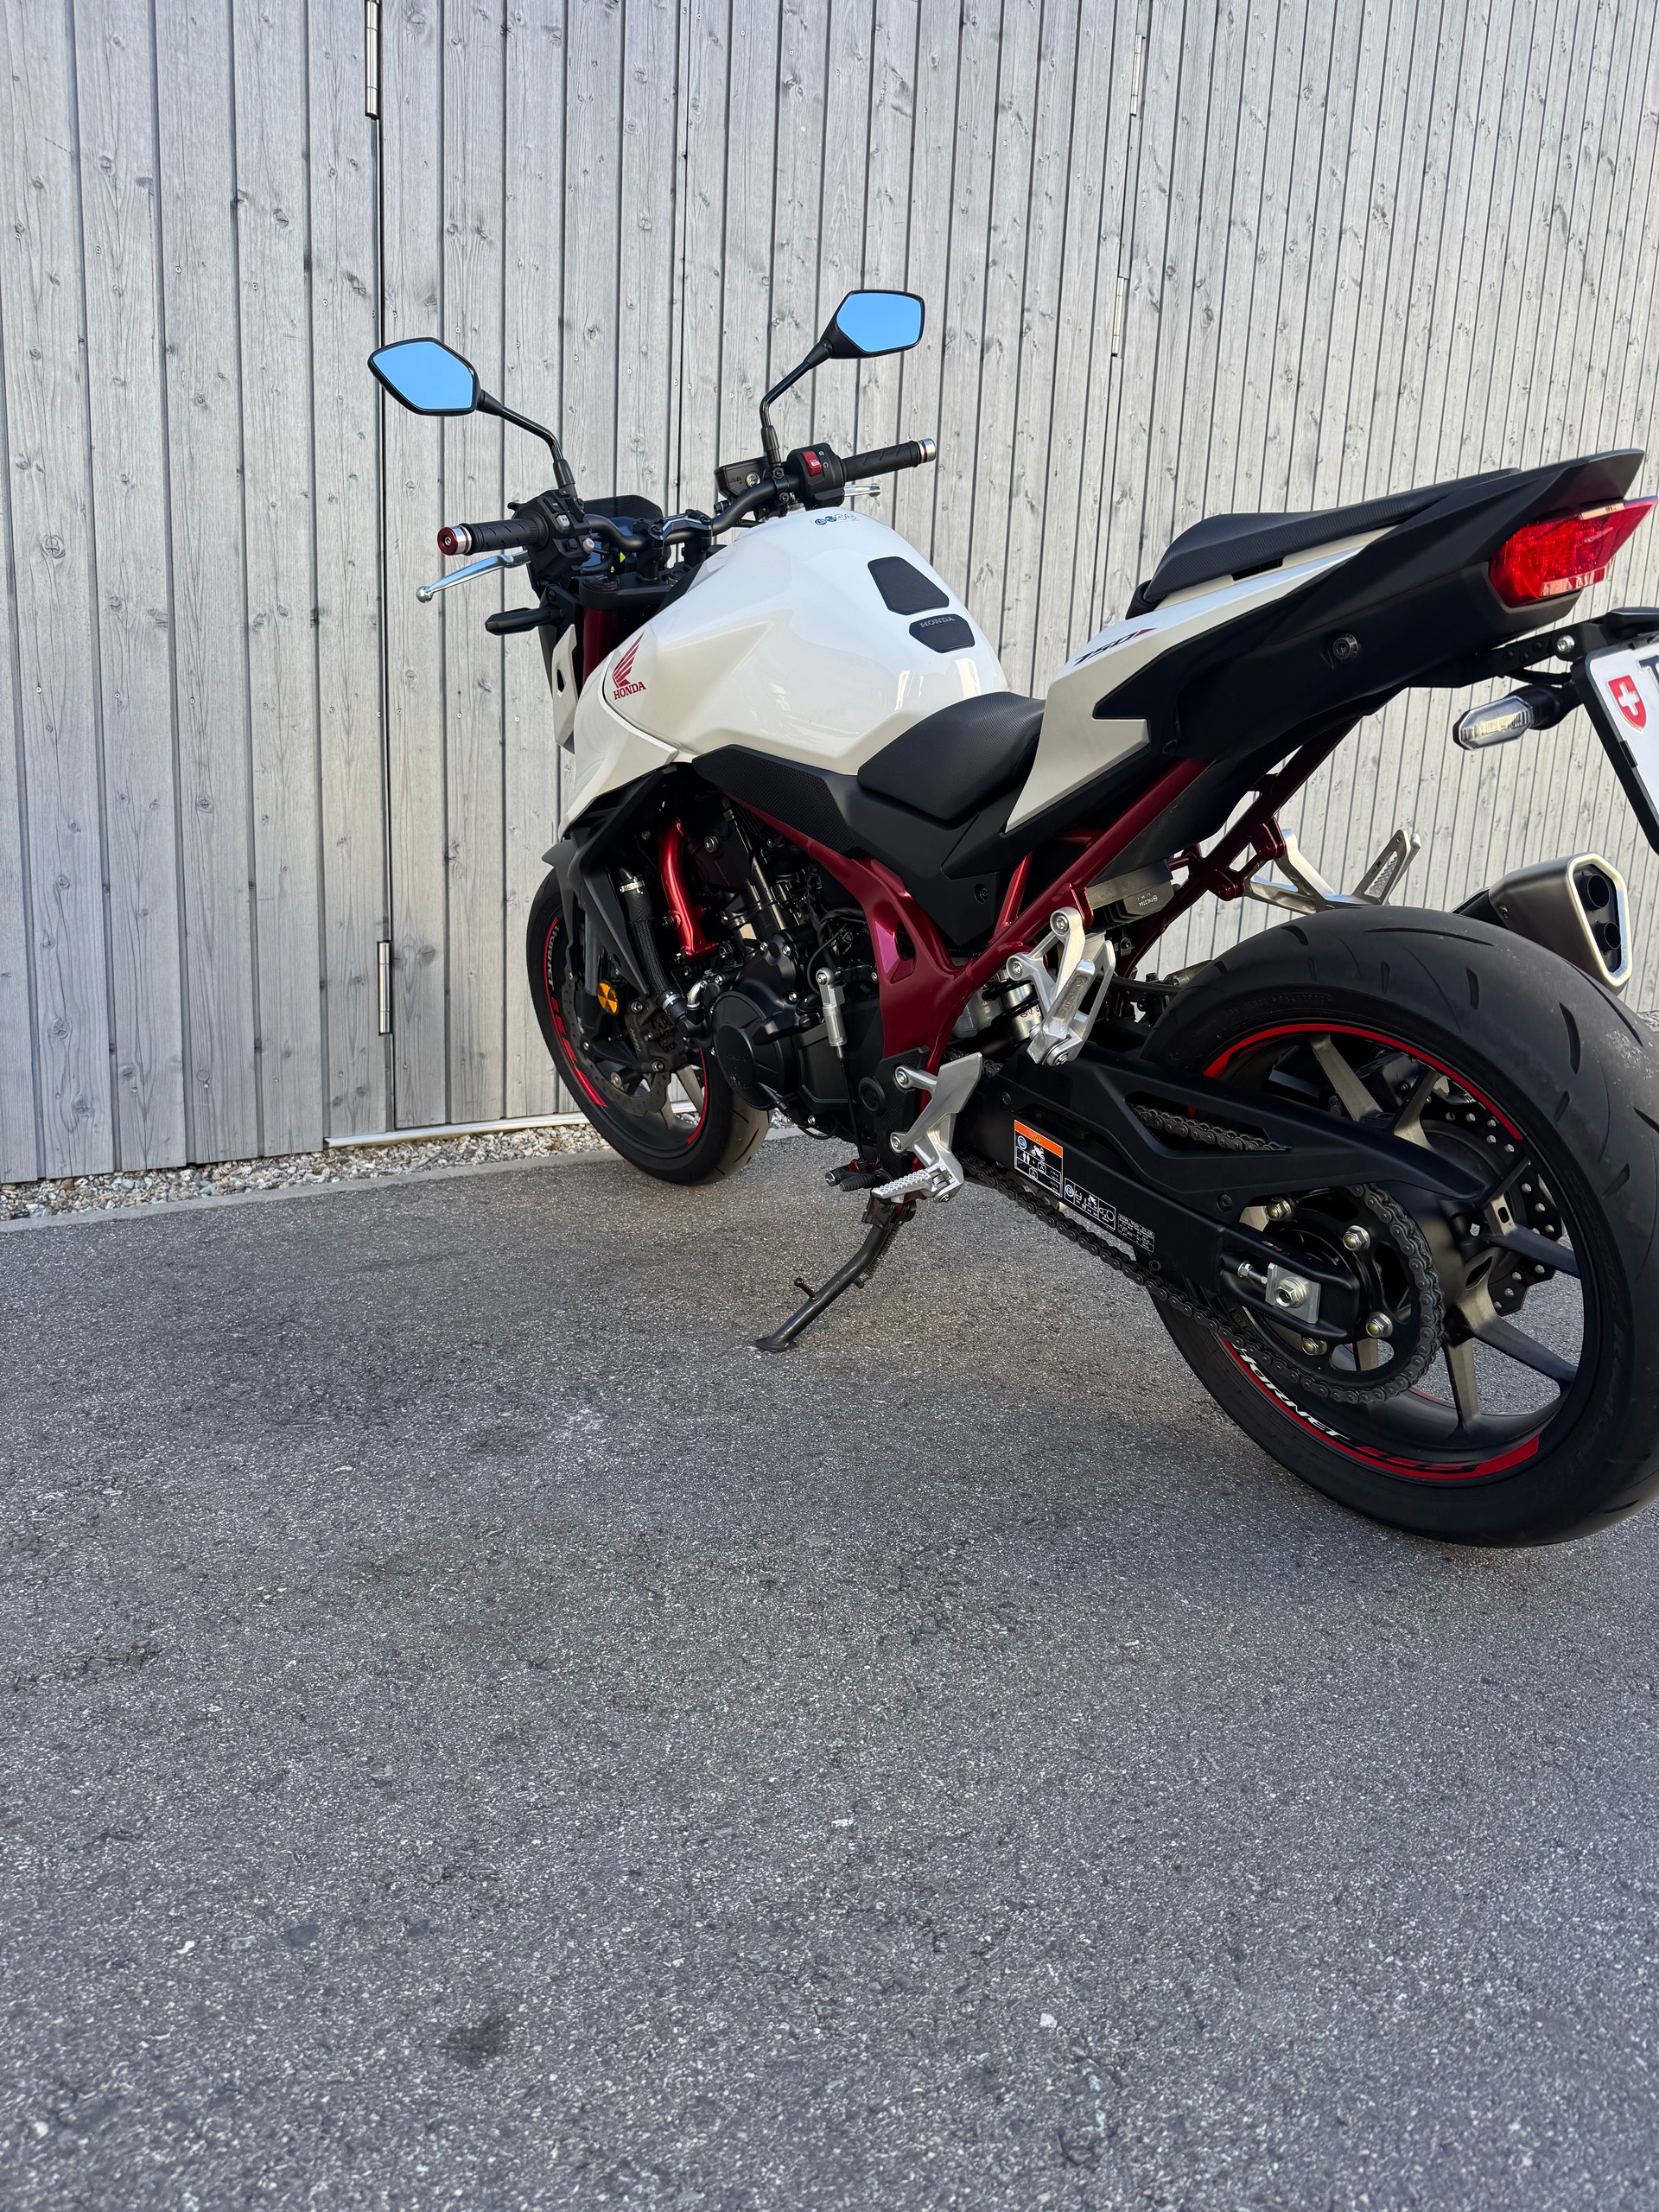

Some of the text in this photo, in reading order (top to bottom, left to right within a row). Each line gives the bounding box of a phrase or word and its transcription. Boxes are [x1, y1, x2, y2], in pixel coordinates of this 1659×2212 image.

[919, 616, 956, 628] HONDA
[1073, 630, 1139, 666] 750
[613, 681, 646, 701] HONDA
[547, 925, 560, 991] HORNET
[1231, 1342, 1351, 1440] HORNET
